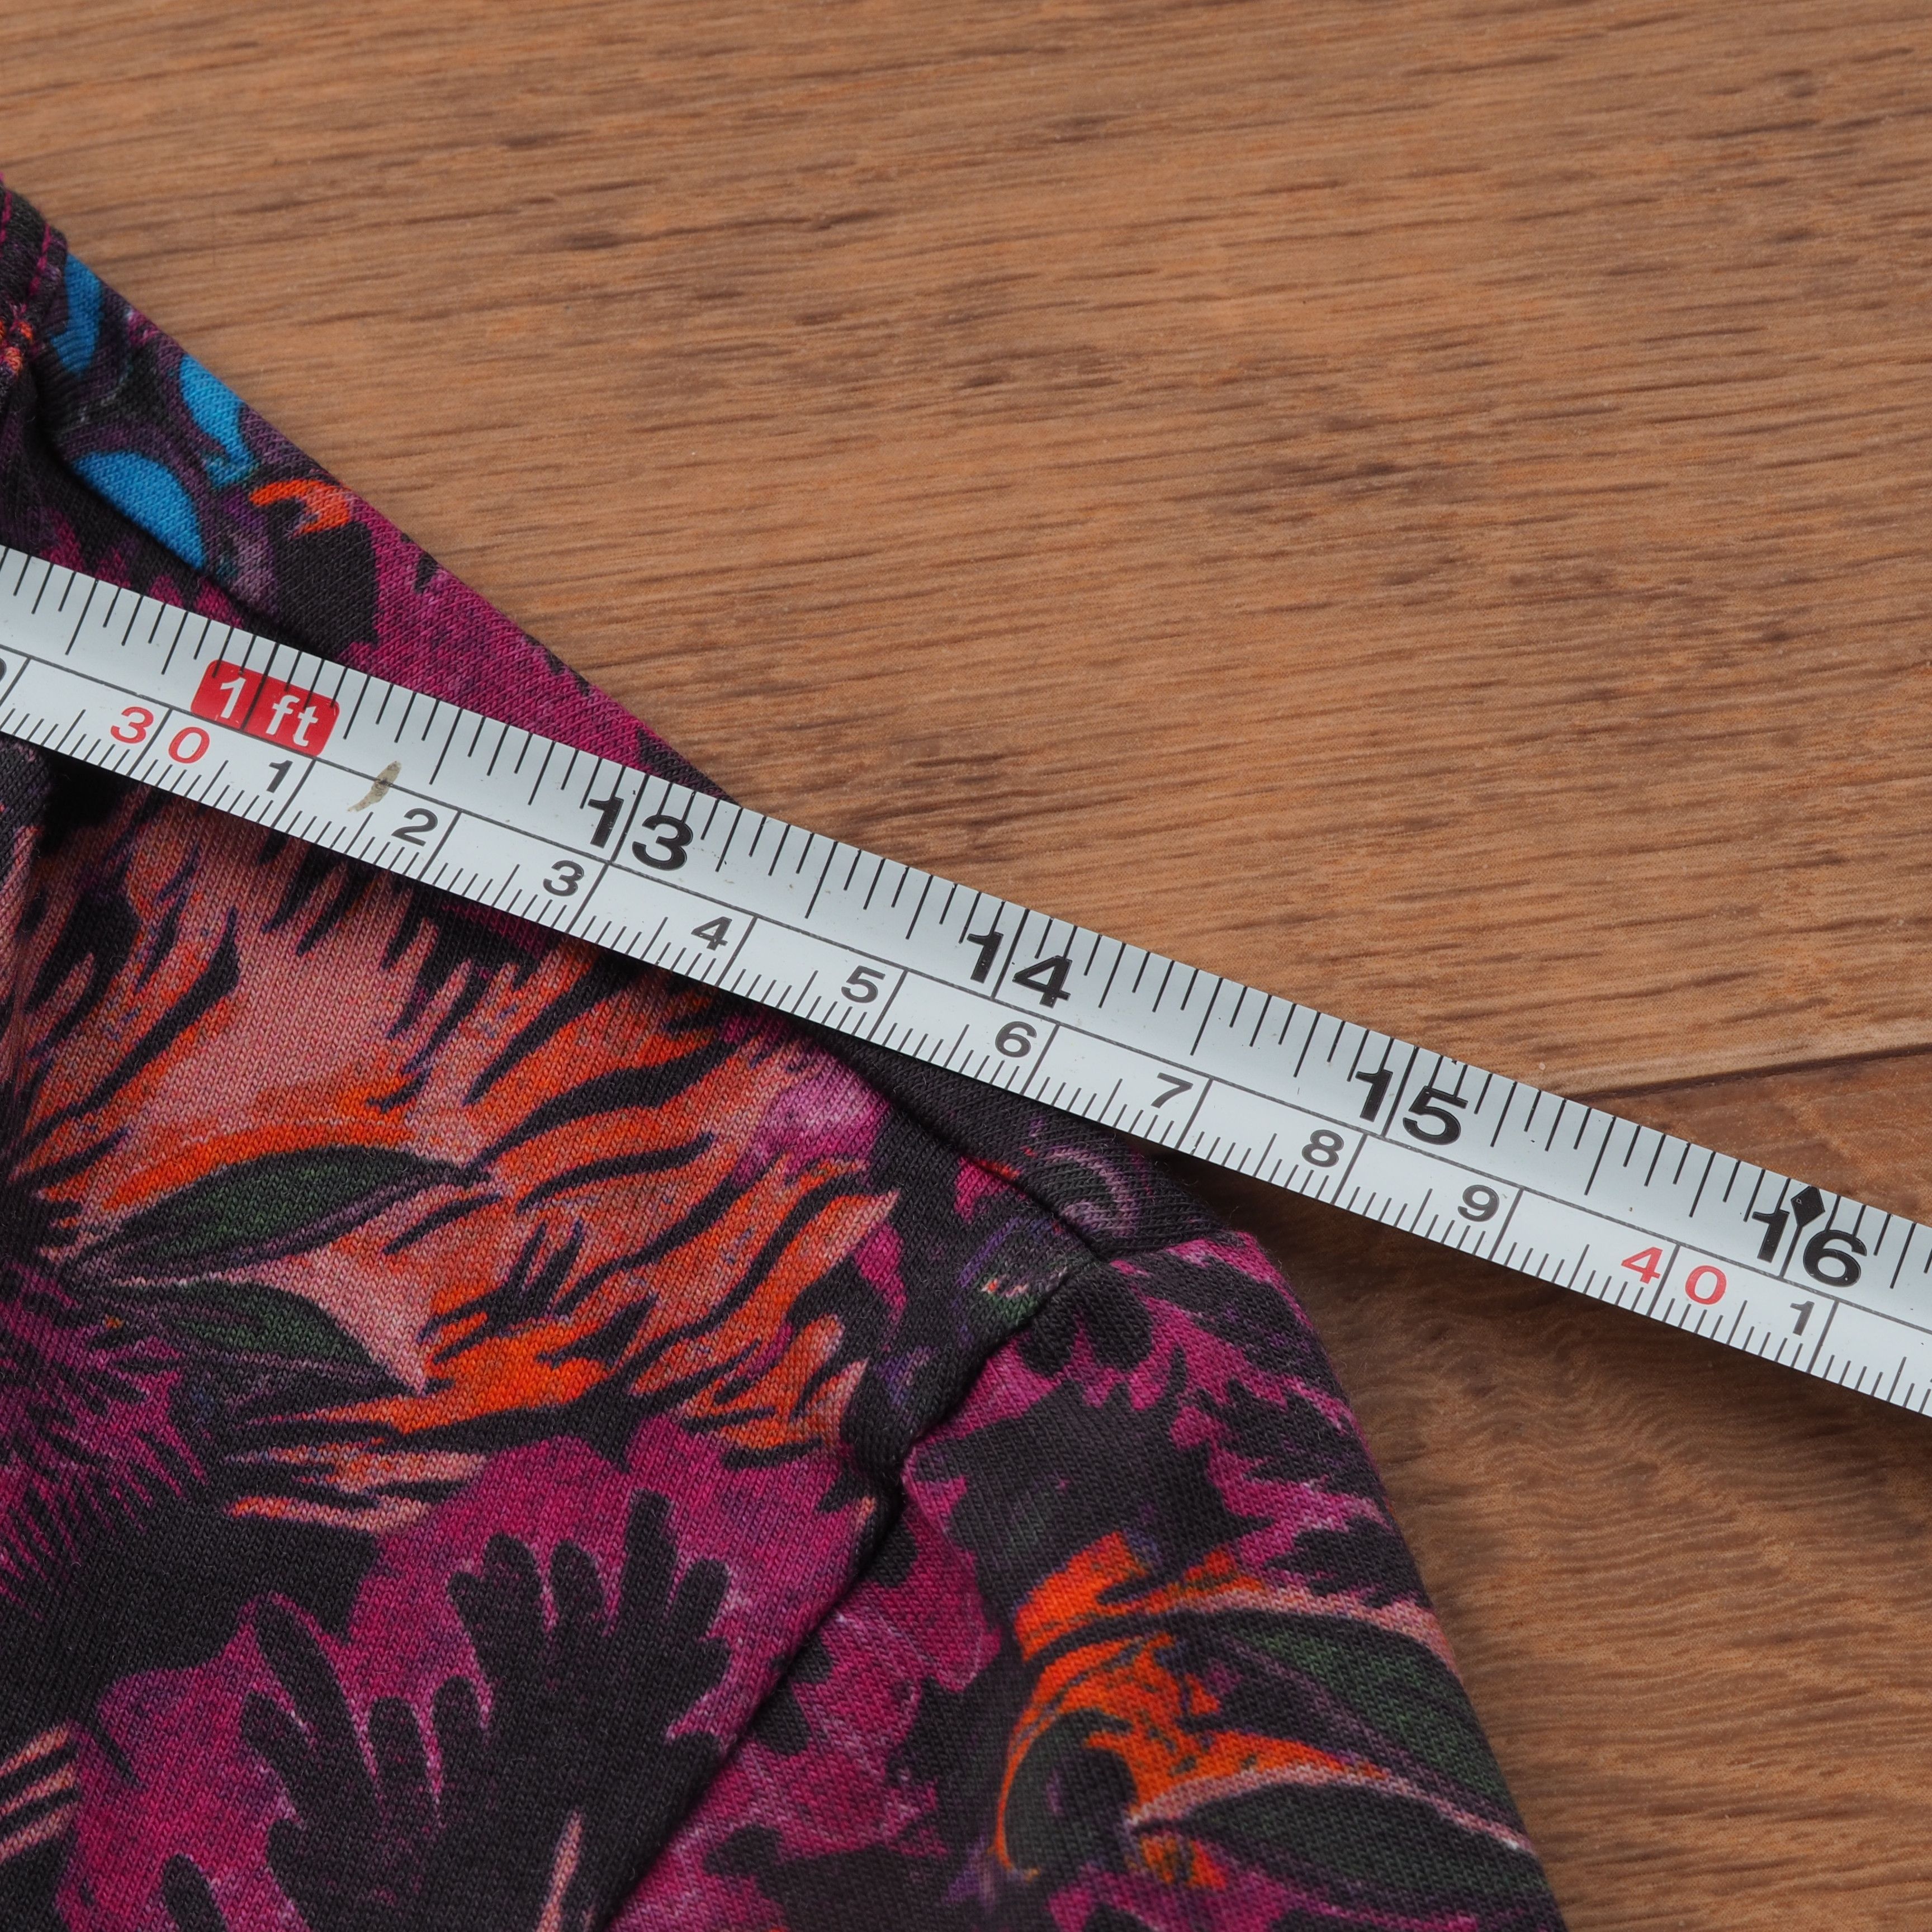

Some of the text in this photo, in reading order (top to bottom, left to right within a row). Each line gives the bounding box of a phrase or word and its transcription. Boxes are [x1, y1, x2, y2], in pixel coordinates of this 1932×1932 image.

[220, 677, 319, 748] 1 ft
[110, 706, 210, 764] 30
[267, 759, 293, 793] 1
[392, 808, 438, 846] 2
[588, 796, 694, 870] 13
[543, 860, 584, 897] 3
[692, 917, 732, 950] 4
[841, 965, 886, 1004] 5
[967, 931, 1070, 1007] 14
[995, 1021, 1038, 1058] 6
[1149, 1073, 1193, 1109] 7
[1355, 1069, 1467, 1146] 15
[1302, 1129, 1344, 1168] 8
[1457, 1185, 1500, 1222] 9
[1753, 1207, 1867, 1288] 16
[1621, 1246, 1727, 1305] 40
[1790, 1300, 1816, 1336] 1
